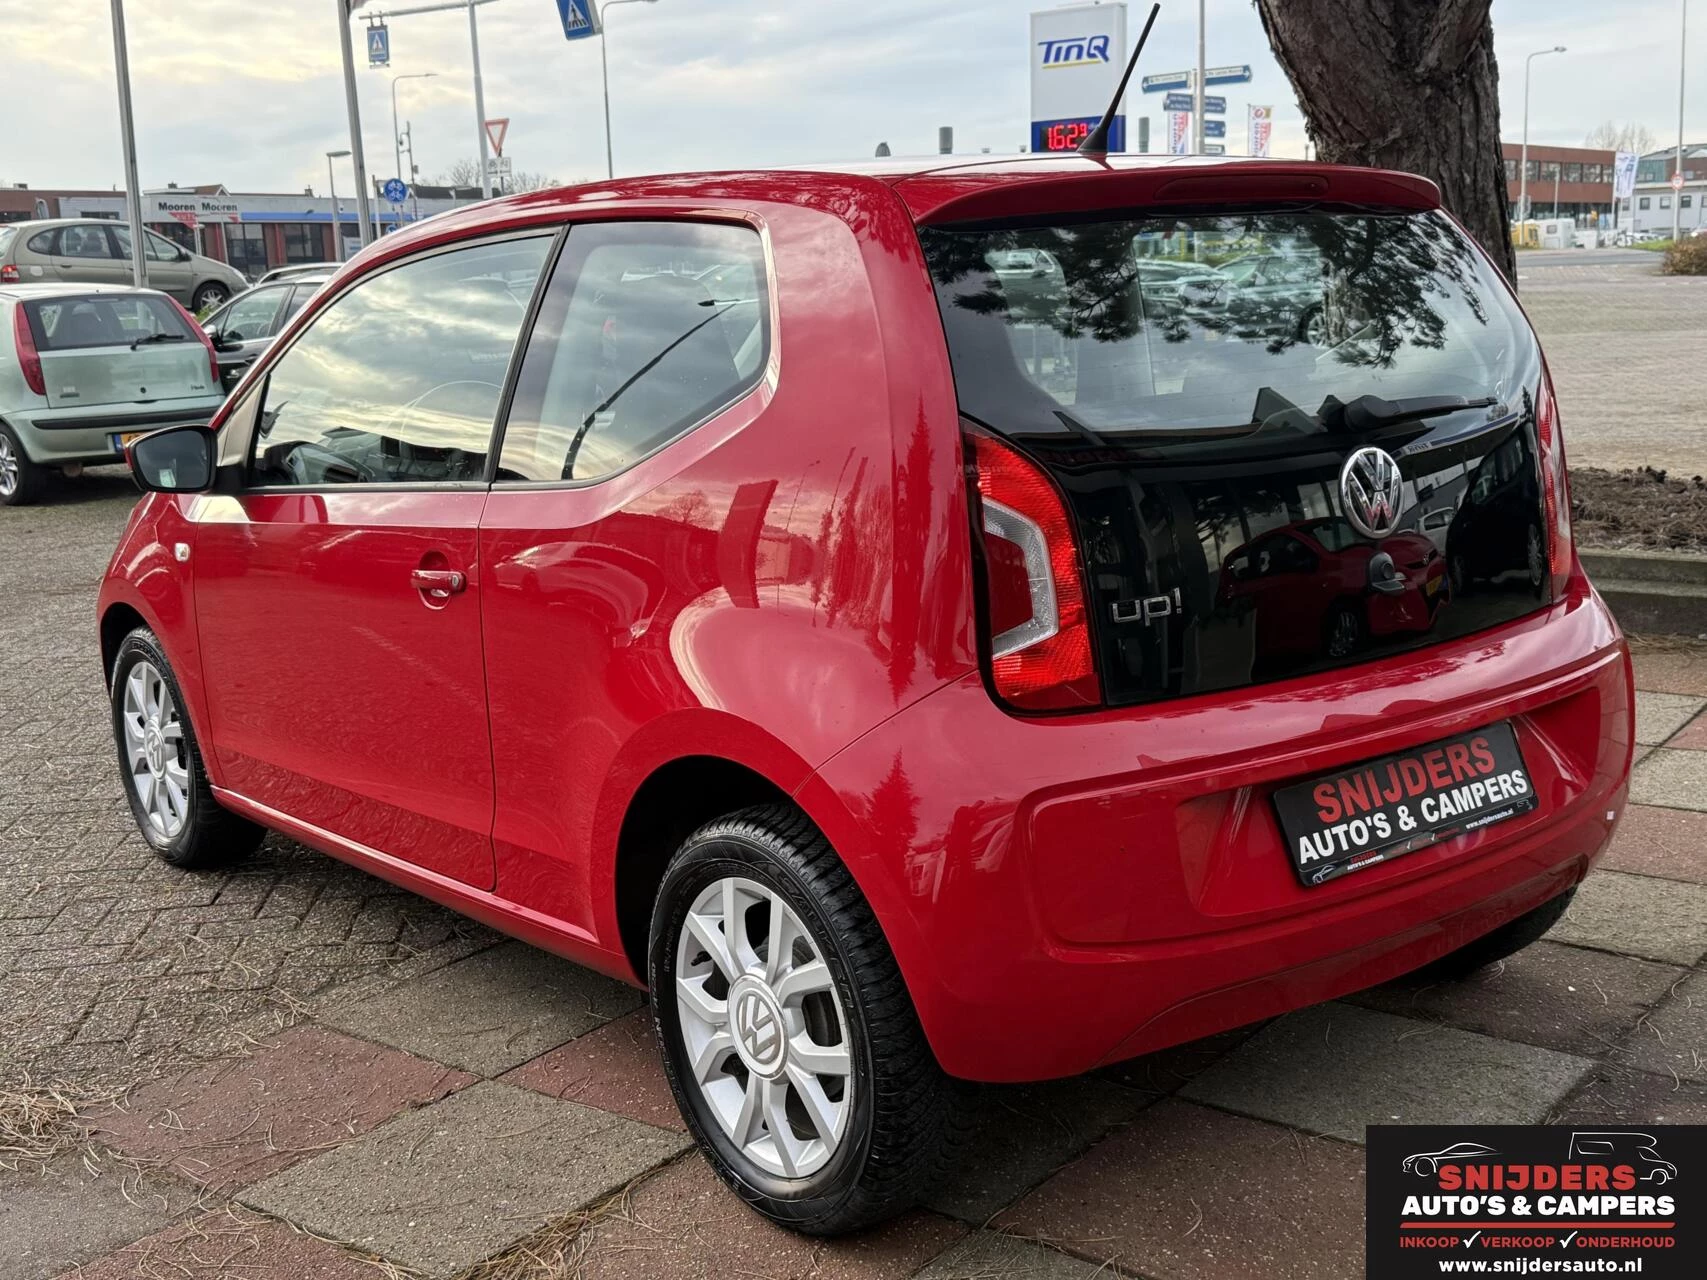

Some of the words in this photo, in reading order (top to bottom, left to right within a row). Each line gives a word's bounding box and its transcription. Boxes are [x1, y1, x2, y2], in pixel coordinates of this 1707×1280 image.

[158, 202, 196, 211] Mooren
[1112, 587, 1182, 627] up!
[1313, 737, 1495, 823] SNIJDERS
[1299, 813, 1392, 865] AUTO'S
[1396, 804, 1418, 832] &
[1420, 769, 1528, 823] CAMPERS
